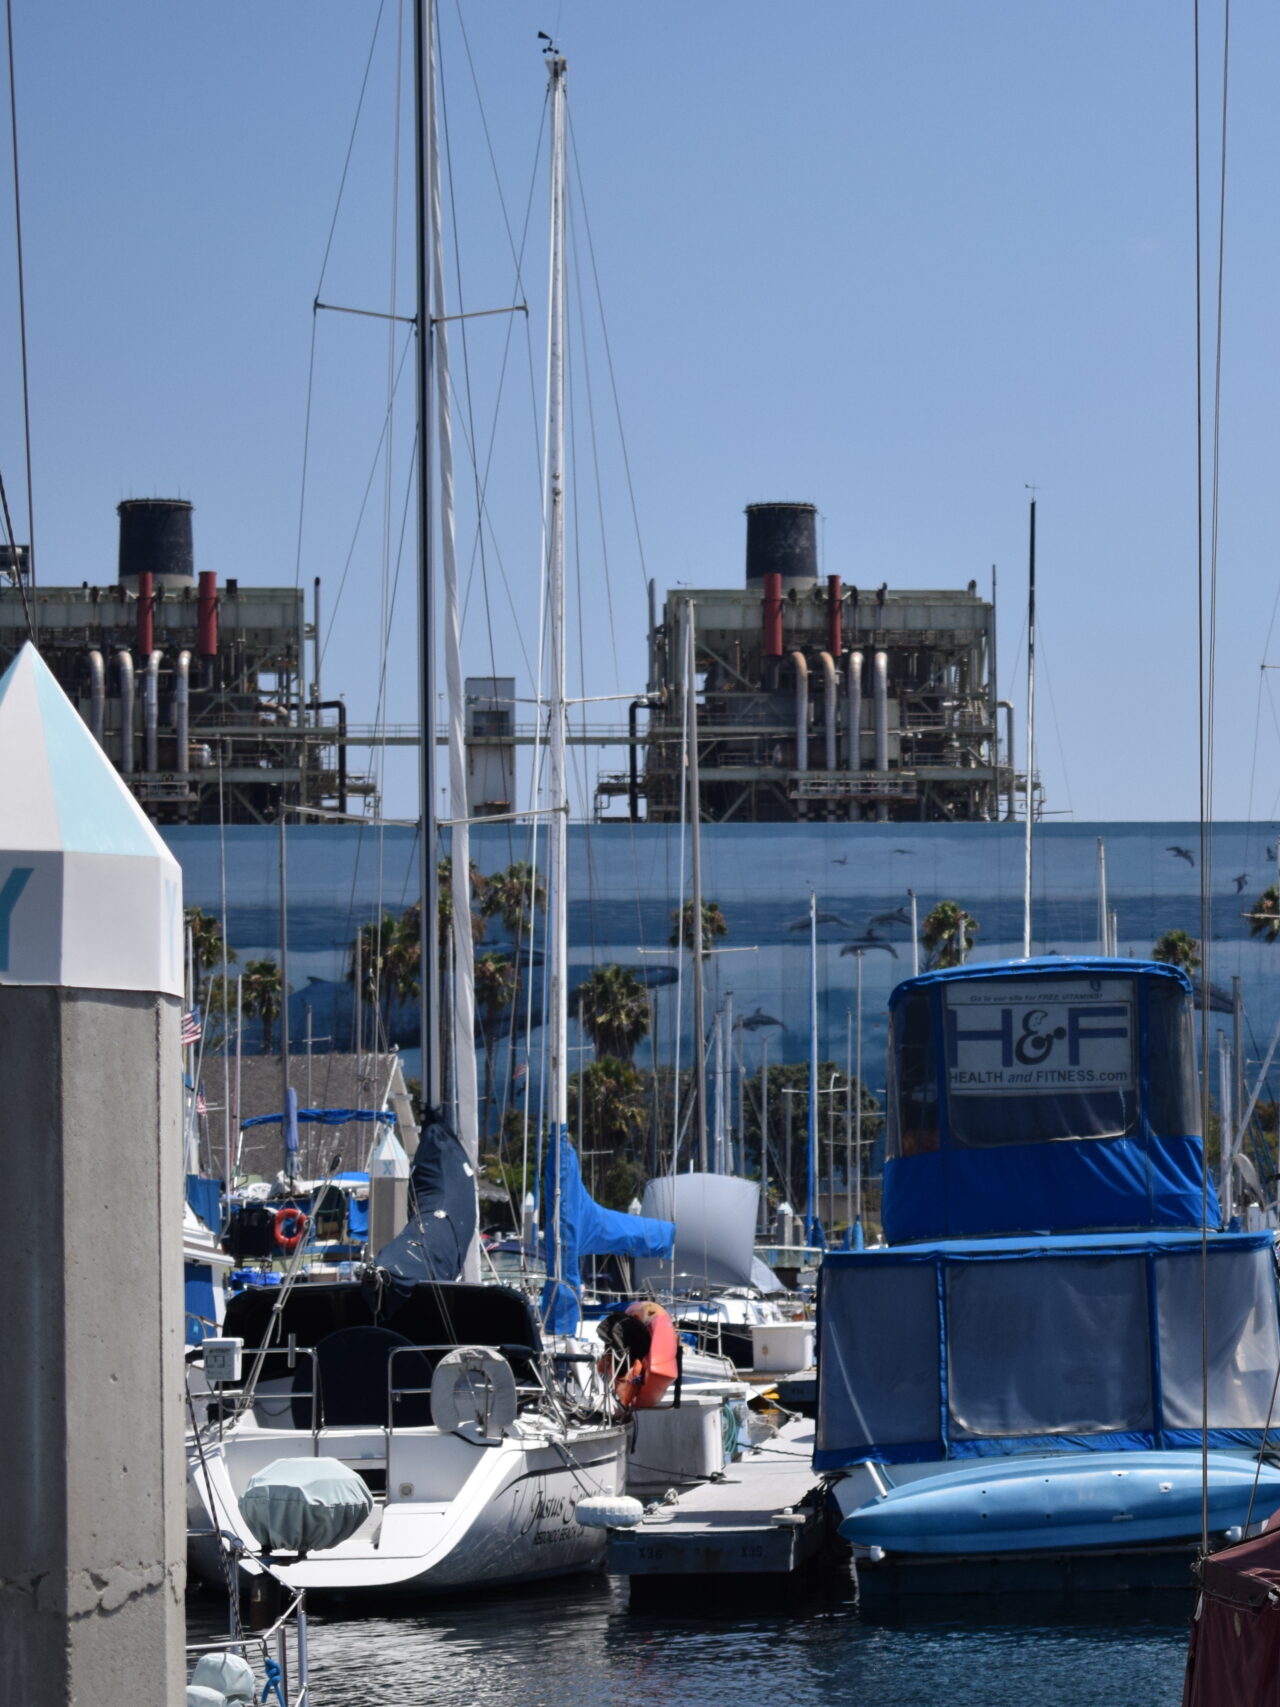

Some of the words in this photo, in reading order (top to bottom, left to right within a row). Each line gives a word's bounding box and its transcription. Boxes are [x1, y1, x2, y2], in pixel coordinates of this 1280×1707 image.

[950, 1071, 1003, 1084] HEALTH
[1007, 1071, 1034, 1084] and
[1036, 1069, 1128, 1083] FITNESS.com
